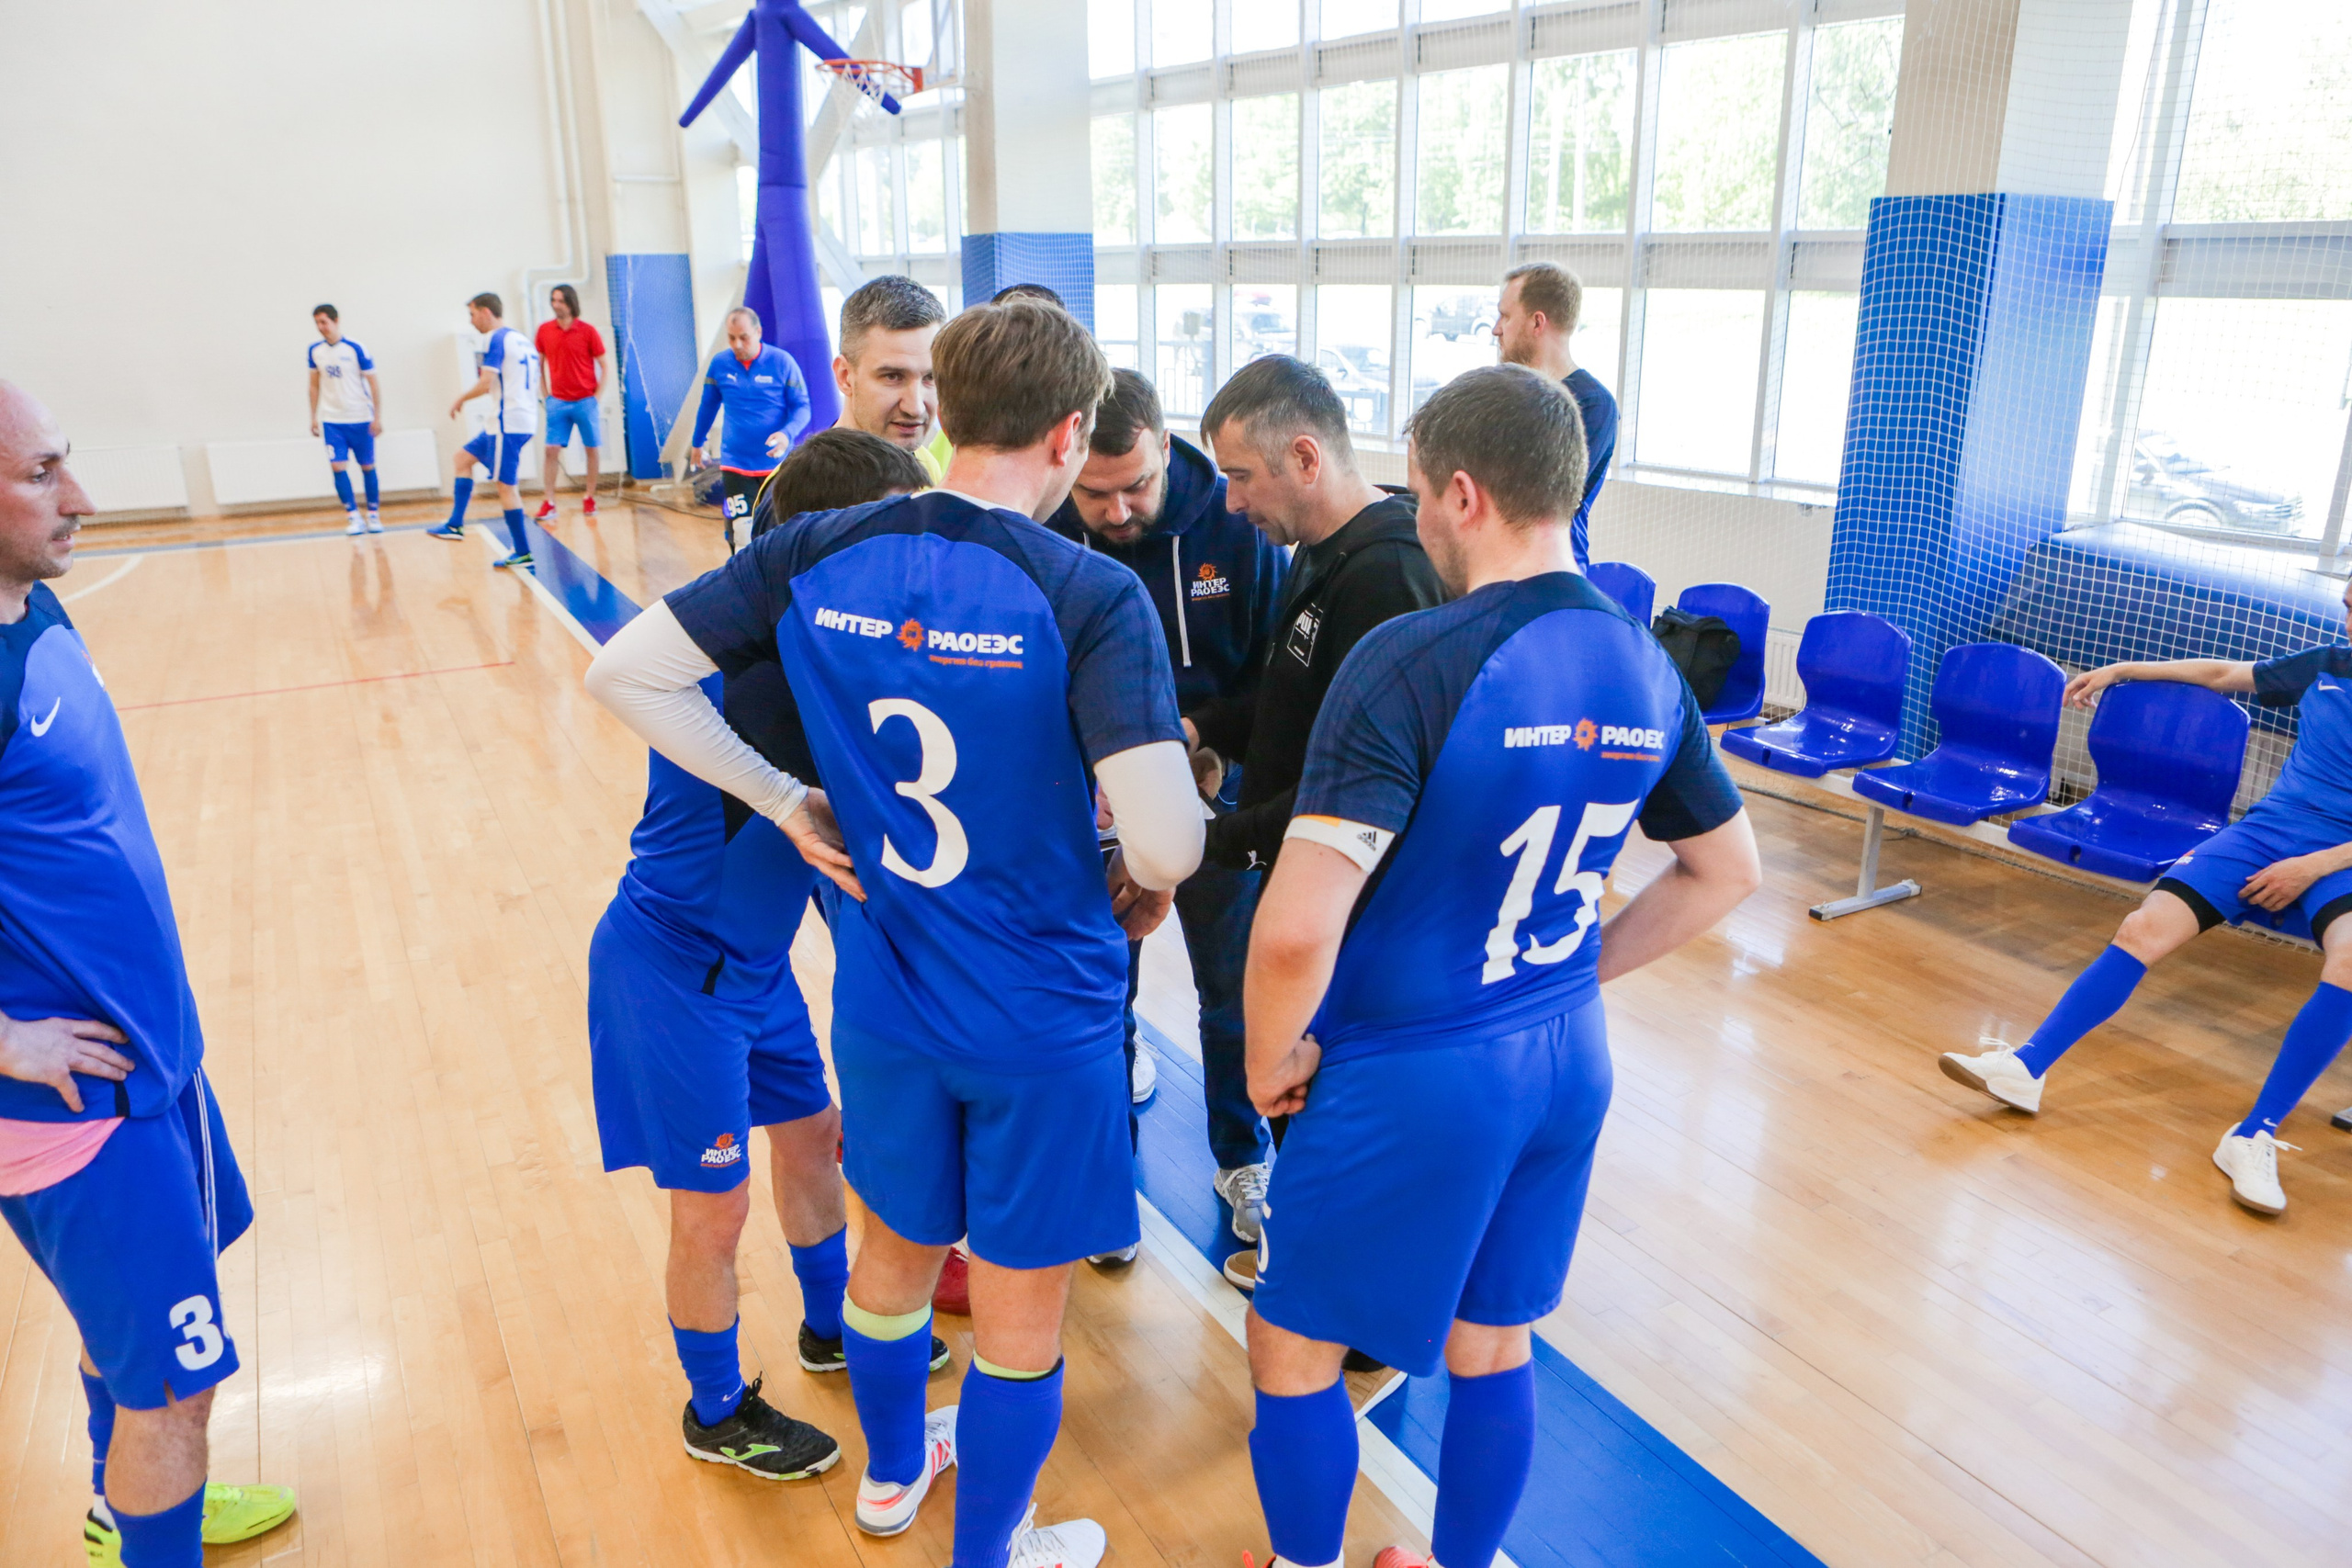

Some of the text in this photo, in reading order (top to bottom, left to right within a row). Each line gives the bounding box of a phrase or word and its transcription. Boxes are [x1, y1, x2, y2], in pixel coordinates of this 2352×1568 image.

[725, 493, 749, 517] 95
[1190, 583, 1230, 597] РАОЕЭС
[1192, 577, 1227, 590] ИНТЕР
[814, 606, 1024, 655] ИНТЕР РАОЕЭС
[1503, 725, 1573, 749] ИНТЕР
[868, 697, 969, 888] 3
[1481, 797, 1641, 986] 15
[705, 1143, 741, 1157] ИНТЕР
[168, 1294, 224, 1371] 3
